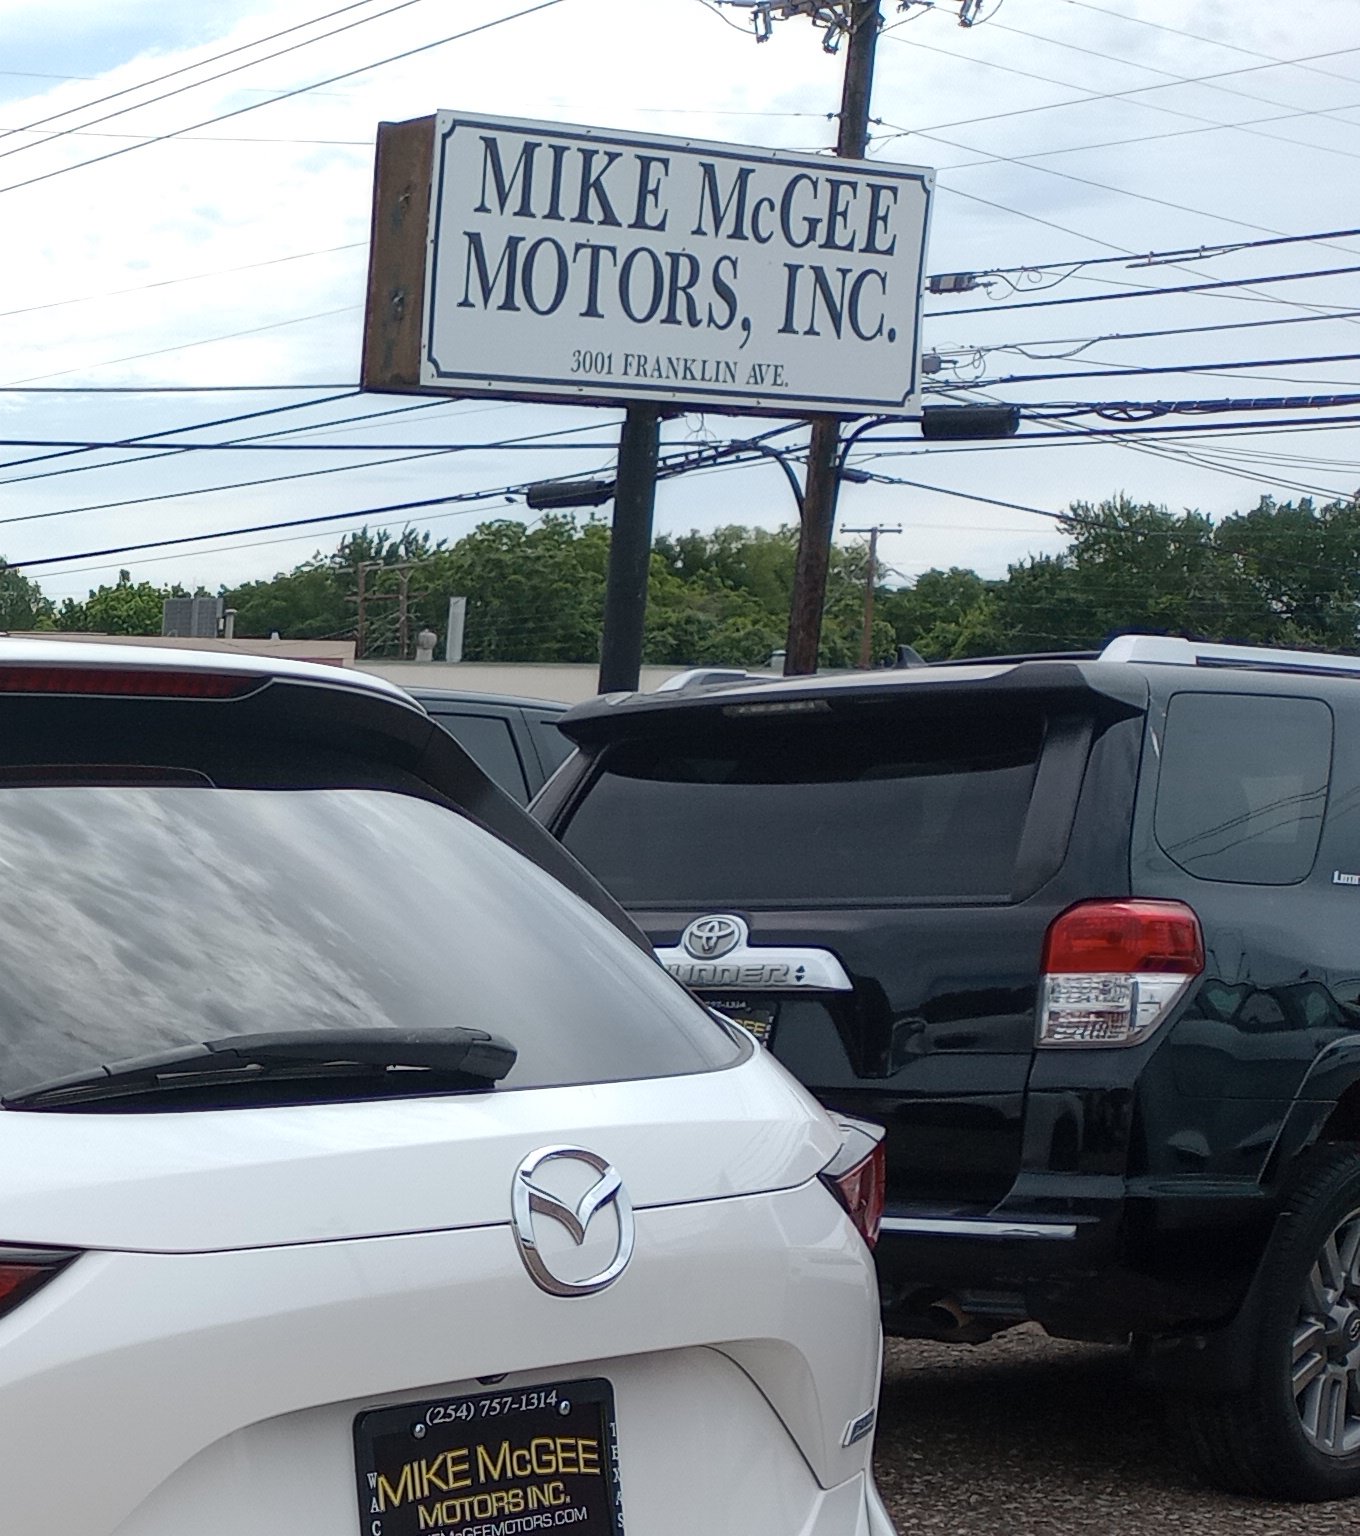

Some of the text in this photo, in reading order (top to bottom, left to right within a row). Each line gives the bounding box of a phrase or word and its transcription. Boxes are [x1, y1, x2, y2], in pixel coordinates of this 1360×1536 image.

[473, 135, 898, 257] MIKE McGEE
[456, 230, 897, 349] MOTORS, INC.
[570, 349, 789, 388] 3001 FRANKLIN AVE.
[425, 1390, 558, 1427] (254) 757-1314
[377, 1437, 601, 1512] MIKE McGEE
[418, 1481, 571, 1531] MOTORS INC.
